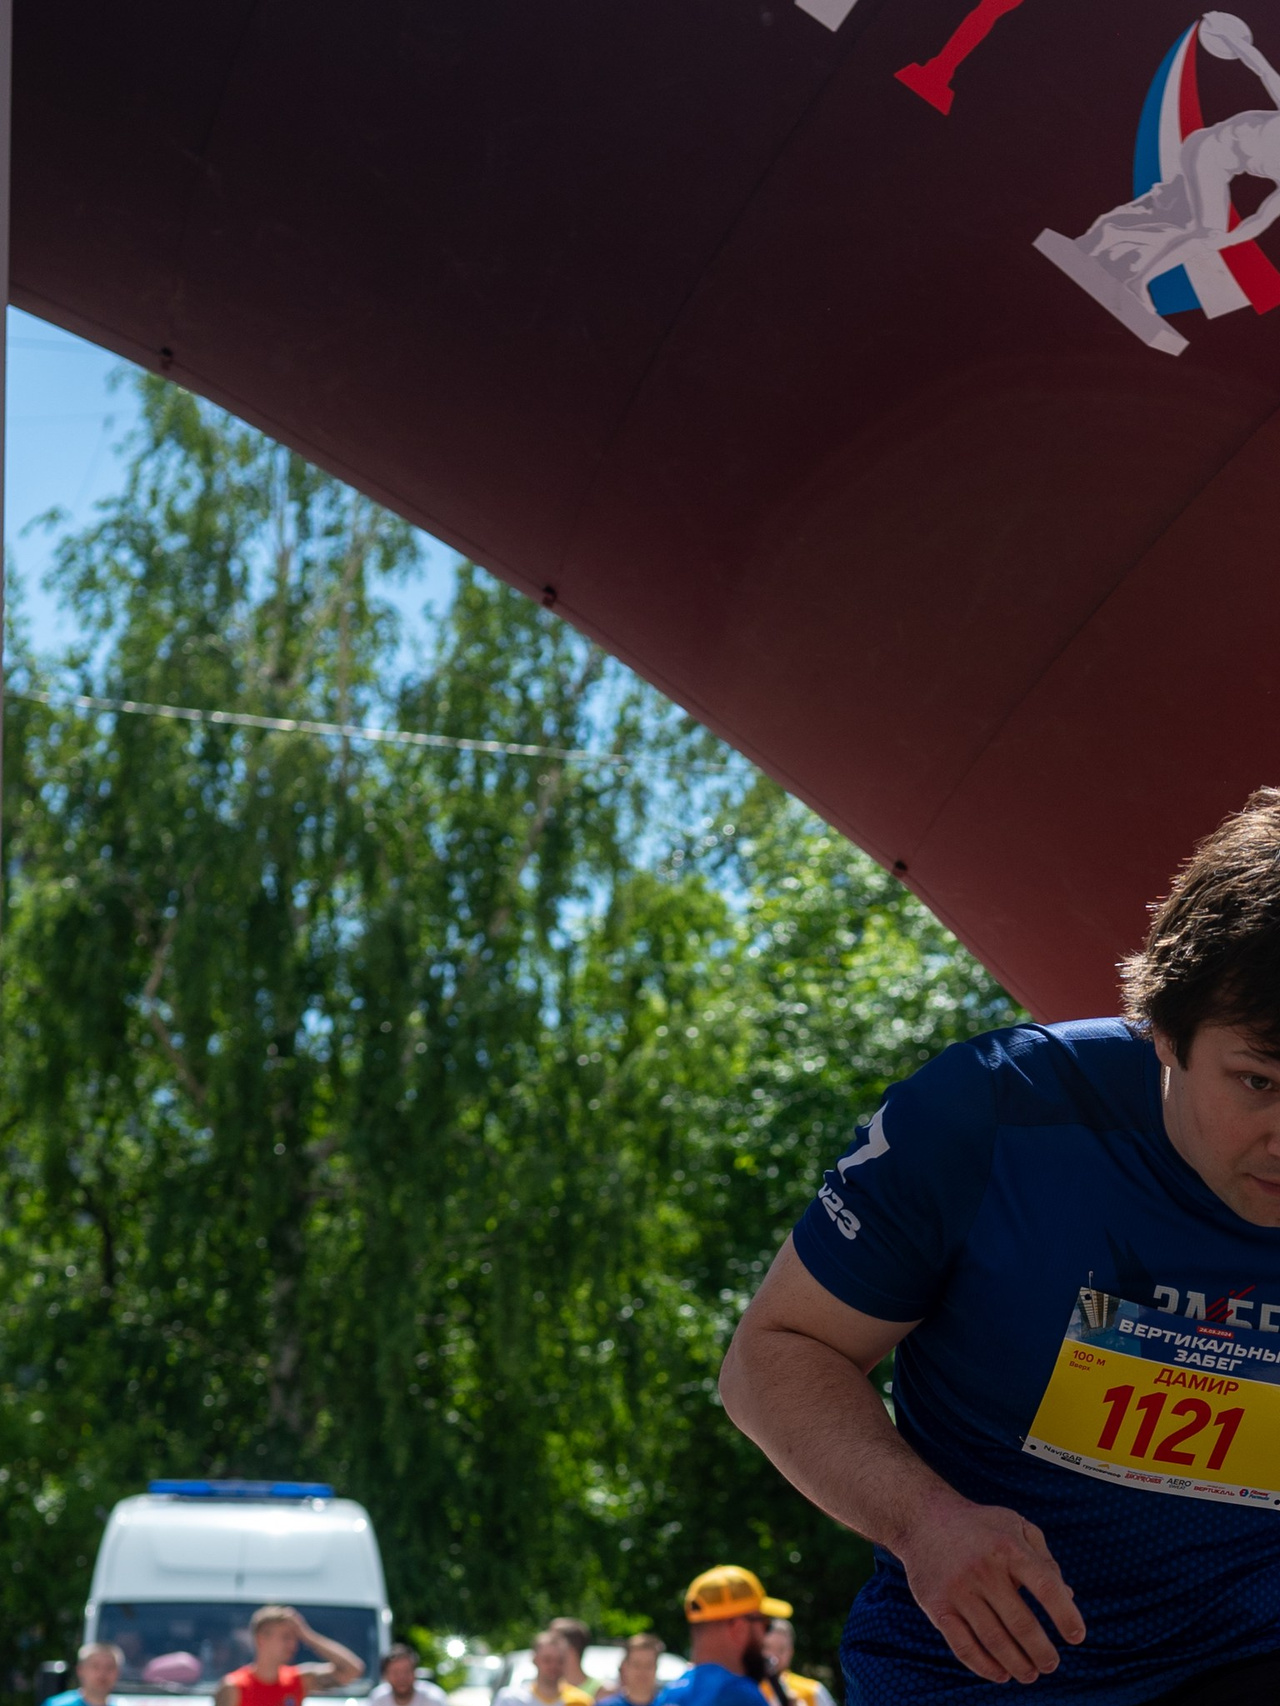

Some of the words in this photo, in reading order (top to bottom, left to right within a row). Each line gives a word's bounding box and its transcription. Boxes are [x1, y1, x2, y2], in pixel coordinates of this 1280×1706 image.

[1072, 1349, 1094, 1363] 100
[1173, 1349, 1243, 1372] ЗАБЕГ
[1069, 1360, 1091, 1372] Вверх
[1153, 1368, 1240, 1396] ДАМИР
[1097, 1384, 1245, 1470] 1121
[1166, 1478, 1192, 1488] AERO
